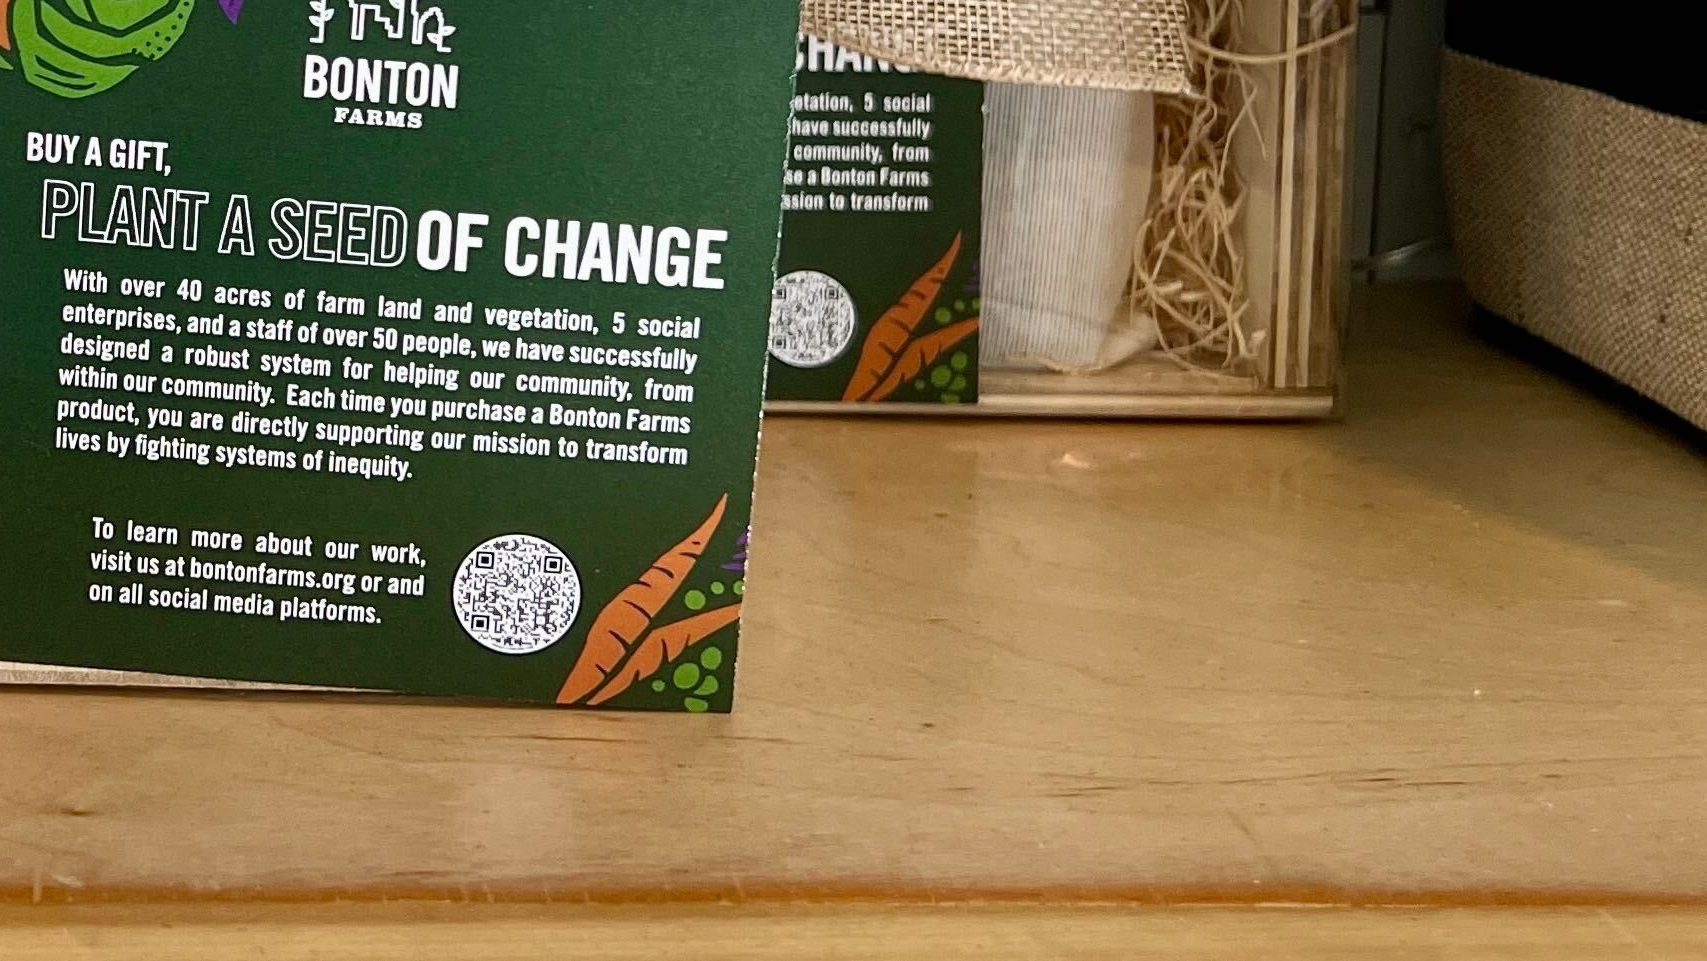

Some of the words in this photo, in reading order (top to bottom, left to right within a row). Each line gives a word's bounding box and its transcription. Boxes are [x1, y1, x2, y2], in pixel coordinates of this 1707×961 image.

[303, 54, 459, 109] BONTON
[883, 92, 932, 113] social
[333, 106, 423, 129] FARMS
[791, 116, 829, 136] have
[832, 117, 931, 141] successfully
[26, 131, 81, 165] BUY
[84, 136, 103, 167] A
[109, 138, 171, 177] GIFT,
[793, 142, 883, 164] community,
[892, 142, 930, 162] from
[807, 169, 817, 186] a
[820, 166, 876, 187] Bonton
[879, 166, 931, 187] Farms
[829, 191, 846, 211] to
[850, 191, 930, 212] transform
[41, 178, 210, 251] PLANT
[217, 193, 255, 256] A
[268, 197, 408, 268] SEED
[416, 209, 490, 273] OF
[504, 216, 729, 290] CHANGE
[63, 268, 108, 294] With
[120, 278, 166, 298] over
[176, 278, 202, 302] 40
[214, 286, 272, 308] acres
[284, 288, 306, 311] of
[316, 290, 365, 316] farm
[377, 294, 422, 320] land
[433, 301, 473, 324] and
[484, 307, 599, 336] vegetation,
[612, 311, 626, 334] 5
[637, 315, 701, 339] social
[62, 302, 182, 335] enterprises,
[186, 313, 224, 336] and
[228, 319, 241, 337] a
[245, 318, 294, 342] staff
[297, 321, 319, 344] of
[322, 327, 369, 348] over
[372, 326, 398, 351] 50
[402, 332, 477, 359] people,
[481, 339, 511, 359] we
[515, 337, 565, 362] have
[568, 345, 698, 375] successfully
[60, 332, 151, 362] designed
[160, 345, 174, 363] a
[184, 344, 250, 370] robust
[260, 353, 332, 377] system
[342, 356, 374, 381] for
[383, 359, 460, 391] helping
[469, 370, 506, 390] our
[515, 374, 633, 403] community,
[644, 377, 694, 403] from
[58, 364, 118, 390] within
[123, 373, 158, 393] our
[161, 377, 276, 408] community.
[286, 383, 336, 409] Each
[340, 388, 386, 413] time
[390, 396, 427, 418] you
[431, 398, 527, 423] purchase
[530, 406, 544, 425] a
[549, 403, 622, 430] Bonton
[626, 408, 691, 434] Farms
[55, 426, 101, 452] lives
[106, 430, 131, 458] by
[134, 433, 211, 465] fighting
[215, 444, 297, 469] systems
[302, 449, 324, 471] of
[328, 450, 413, 482] inequity.
[57, 398, 140, 427] product,
[147, 407, 183, 429] you
[189, 411, 224, 431] are
[231, 410, 309, 443] directly
[315, 422, 425, 452] supporting
[430, 431, 467, 451] our
[472, 430, 551, 456] mission
[557, 436, 579, 458] to
[585, 438, 688, 466] transform
[92, 516, 114, 540] To
[126, 519, 178, 545] learn
[191, 530, 243, 551] more
[255, 531, 313, 557] about
[324, 541, 360, 560] our
[371, 542, 426, 568] work,
[90, 548, 133, 573] visit
[137, 556, 160, 575] us
[164, 556, 186, 577] at
[189, 556, 357, 595] bontonfarms.org
[360, 575, 383, 593] or
[387, 574, 425, 596] and
[89, 584, 113, 603] on
[118, 582, 143, 605] all
[148, 587, 208, 611] social
[213, 592, 274, 616] media
[279, 596, 382, 624] platforms.
